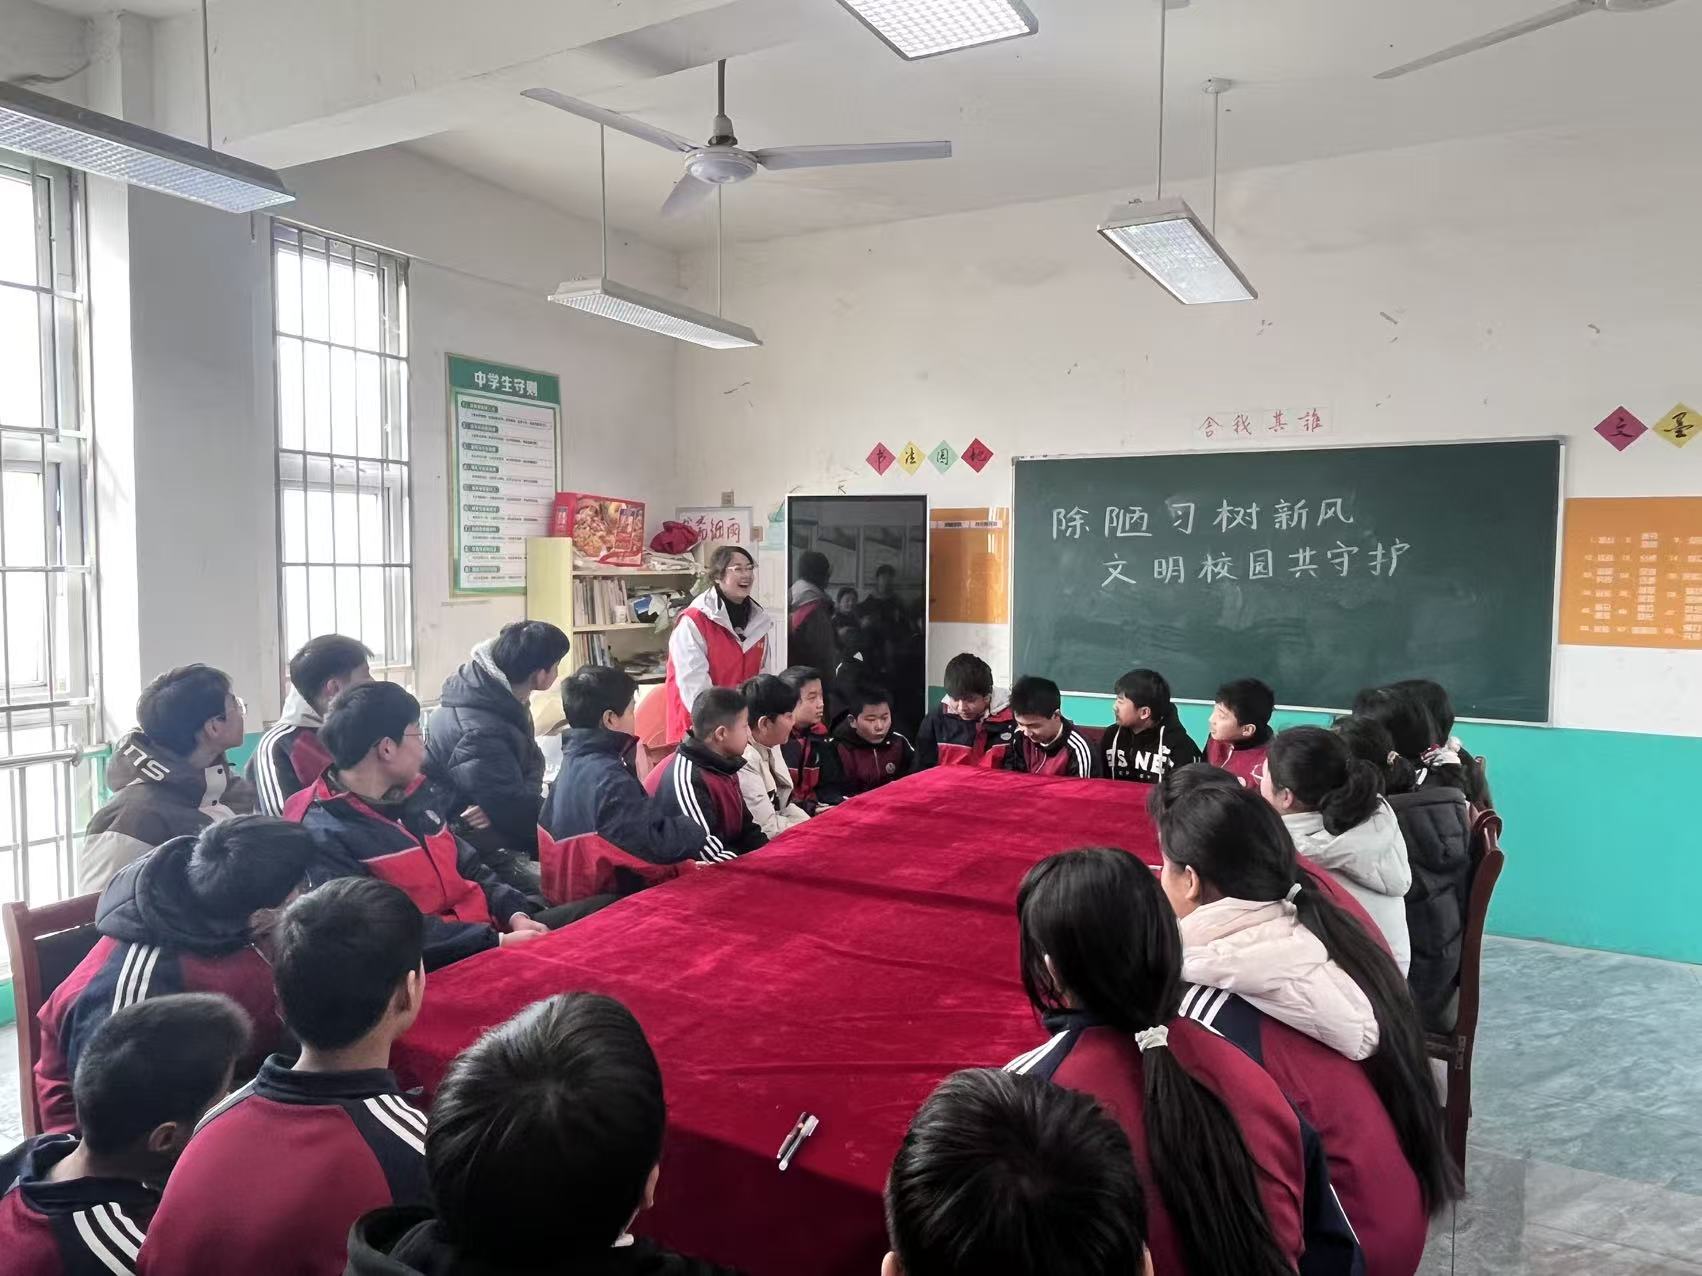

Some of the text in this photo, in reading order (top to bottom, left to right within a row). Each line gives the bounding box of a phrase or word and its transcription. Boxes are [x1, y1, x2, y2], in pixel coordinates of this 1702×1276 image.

[474, 371, 538, 397] 中学生守则
[1052, 498, 1354, 540] 除陋习树新风
[1101, 538, 1411, 588] 文明校园共守护
